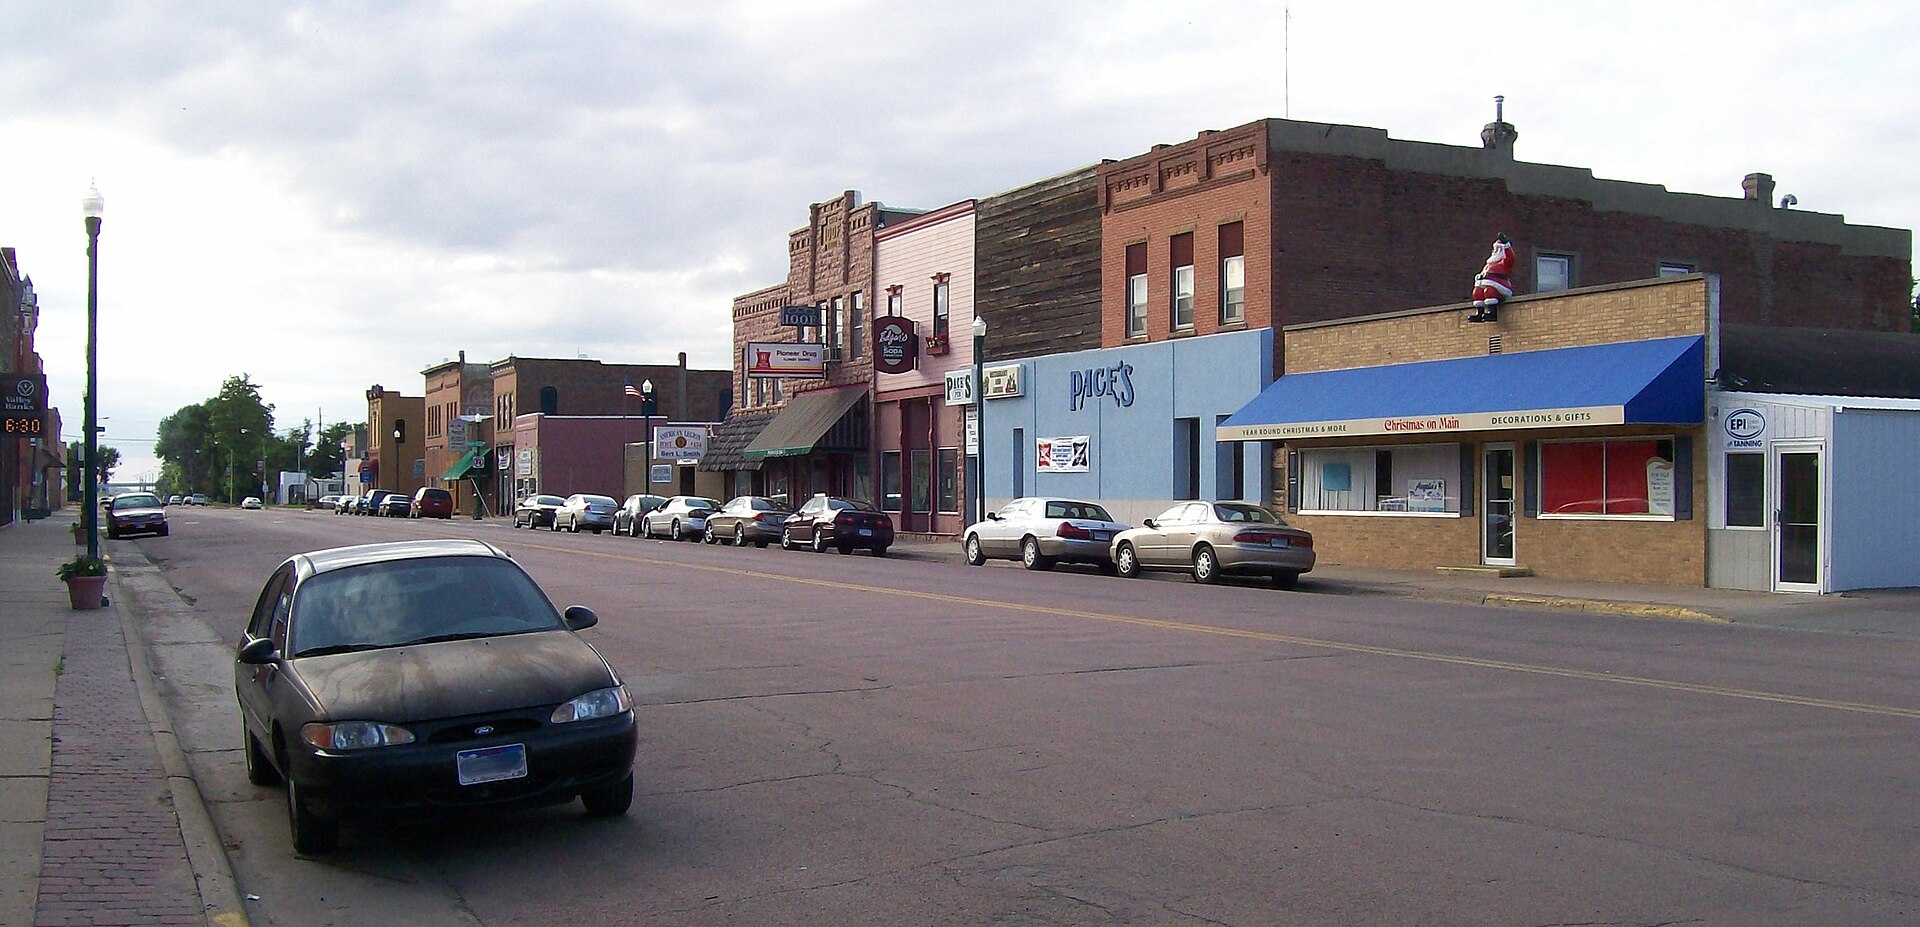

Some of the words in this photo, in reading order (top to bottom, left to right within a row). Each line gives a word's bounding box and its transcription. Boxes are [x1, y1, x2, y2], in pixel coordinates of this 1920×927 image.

[784, 315, 817, 324] IOOF
[1069, 360, 1134, 411] PACE'S
[1384, 418, 1424, 431] Christmas
[1426, 418, 1437, 430] on
[1439, 415, 1460, 429] Main
[1491, 414, 1552, 425] DECORATIONS
[1555, 414, 1562, 422] &
[1564, 412, 1592, 422] GIFTS
[1731, 419, 1746, 430] EPI
[6, 418, 40, 433] 6:30
[1259, 428, 1281, 436] ROUND
[1282, 425, 1319, 434] CHRISTMAS
[1327, 424, 1347, 432] MORE
